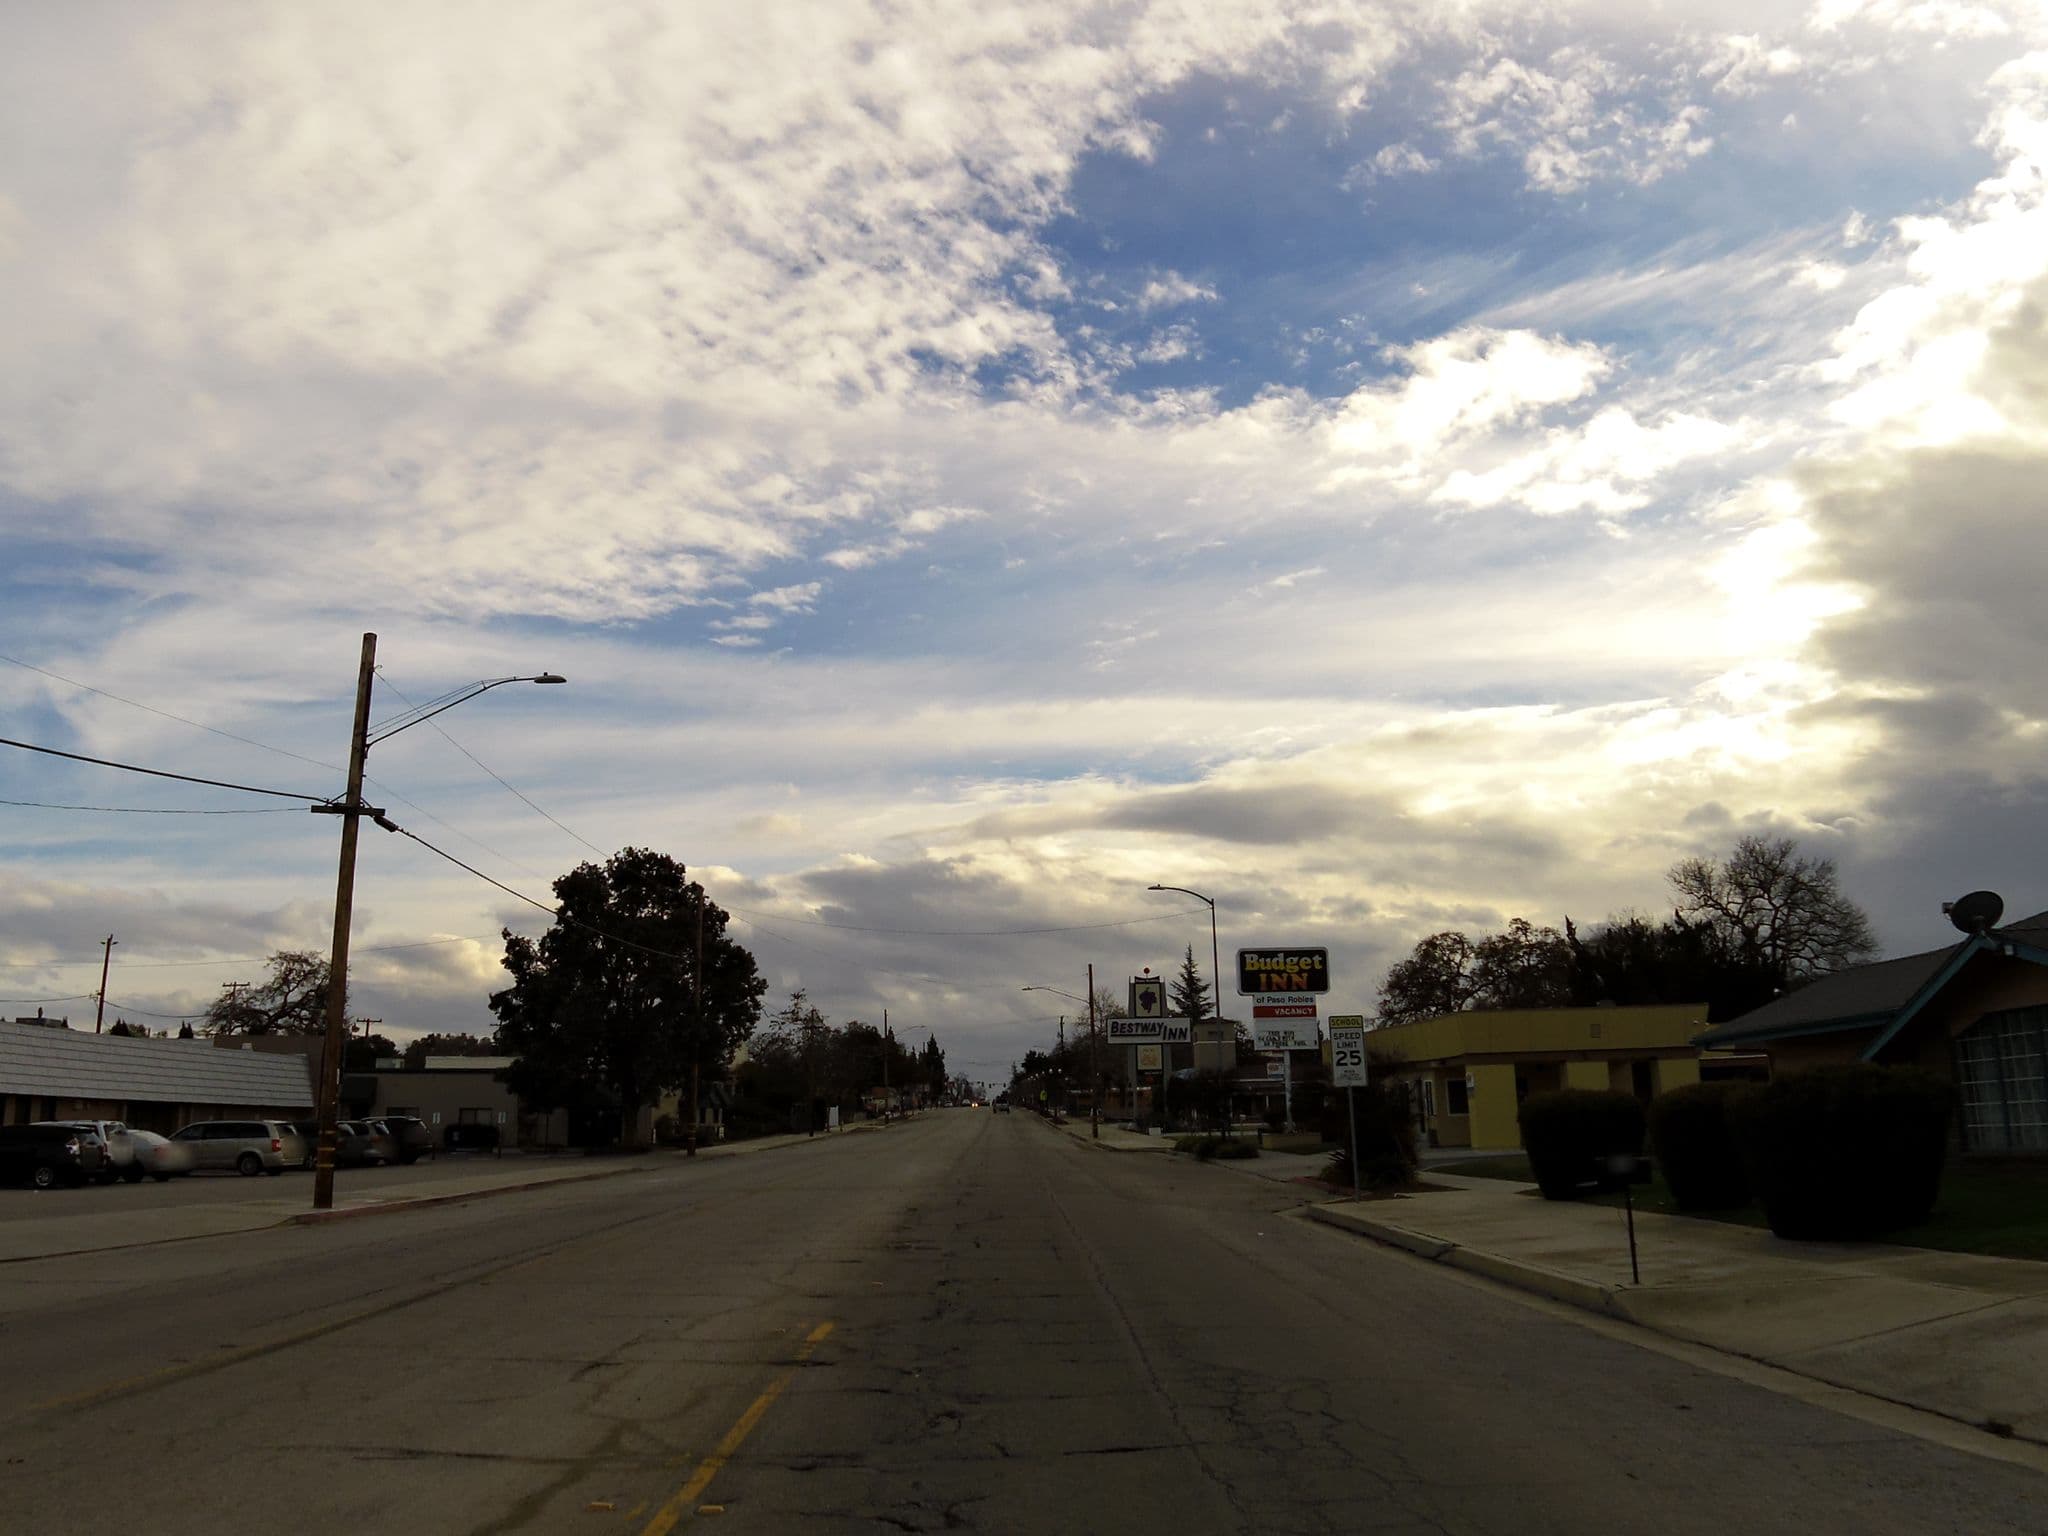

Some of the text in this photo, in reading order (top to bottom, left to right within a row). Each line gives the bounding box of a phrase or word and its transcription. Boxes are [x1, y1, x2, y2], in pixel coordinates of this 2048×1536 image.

[1244, 953, 1323, 972] Budget
[1259, 973, 1309, 991] INN
[1267, 996, 1285, 1004] Paso
[1331, 1018, 1361, 1026] SCHOOL
[1111, 1022, 1188, 1041] BESTWAY INN
[1337, 1041, 1357, 1049] LIMIT
[1336, 1051, 1362, 1067] 25
